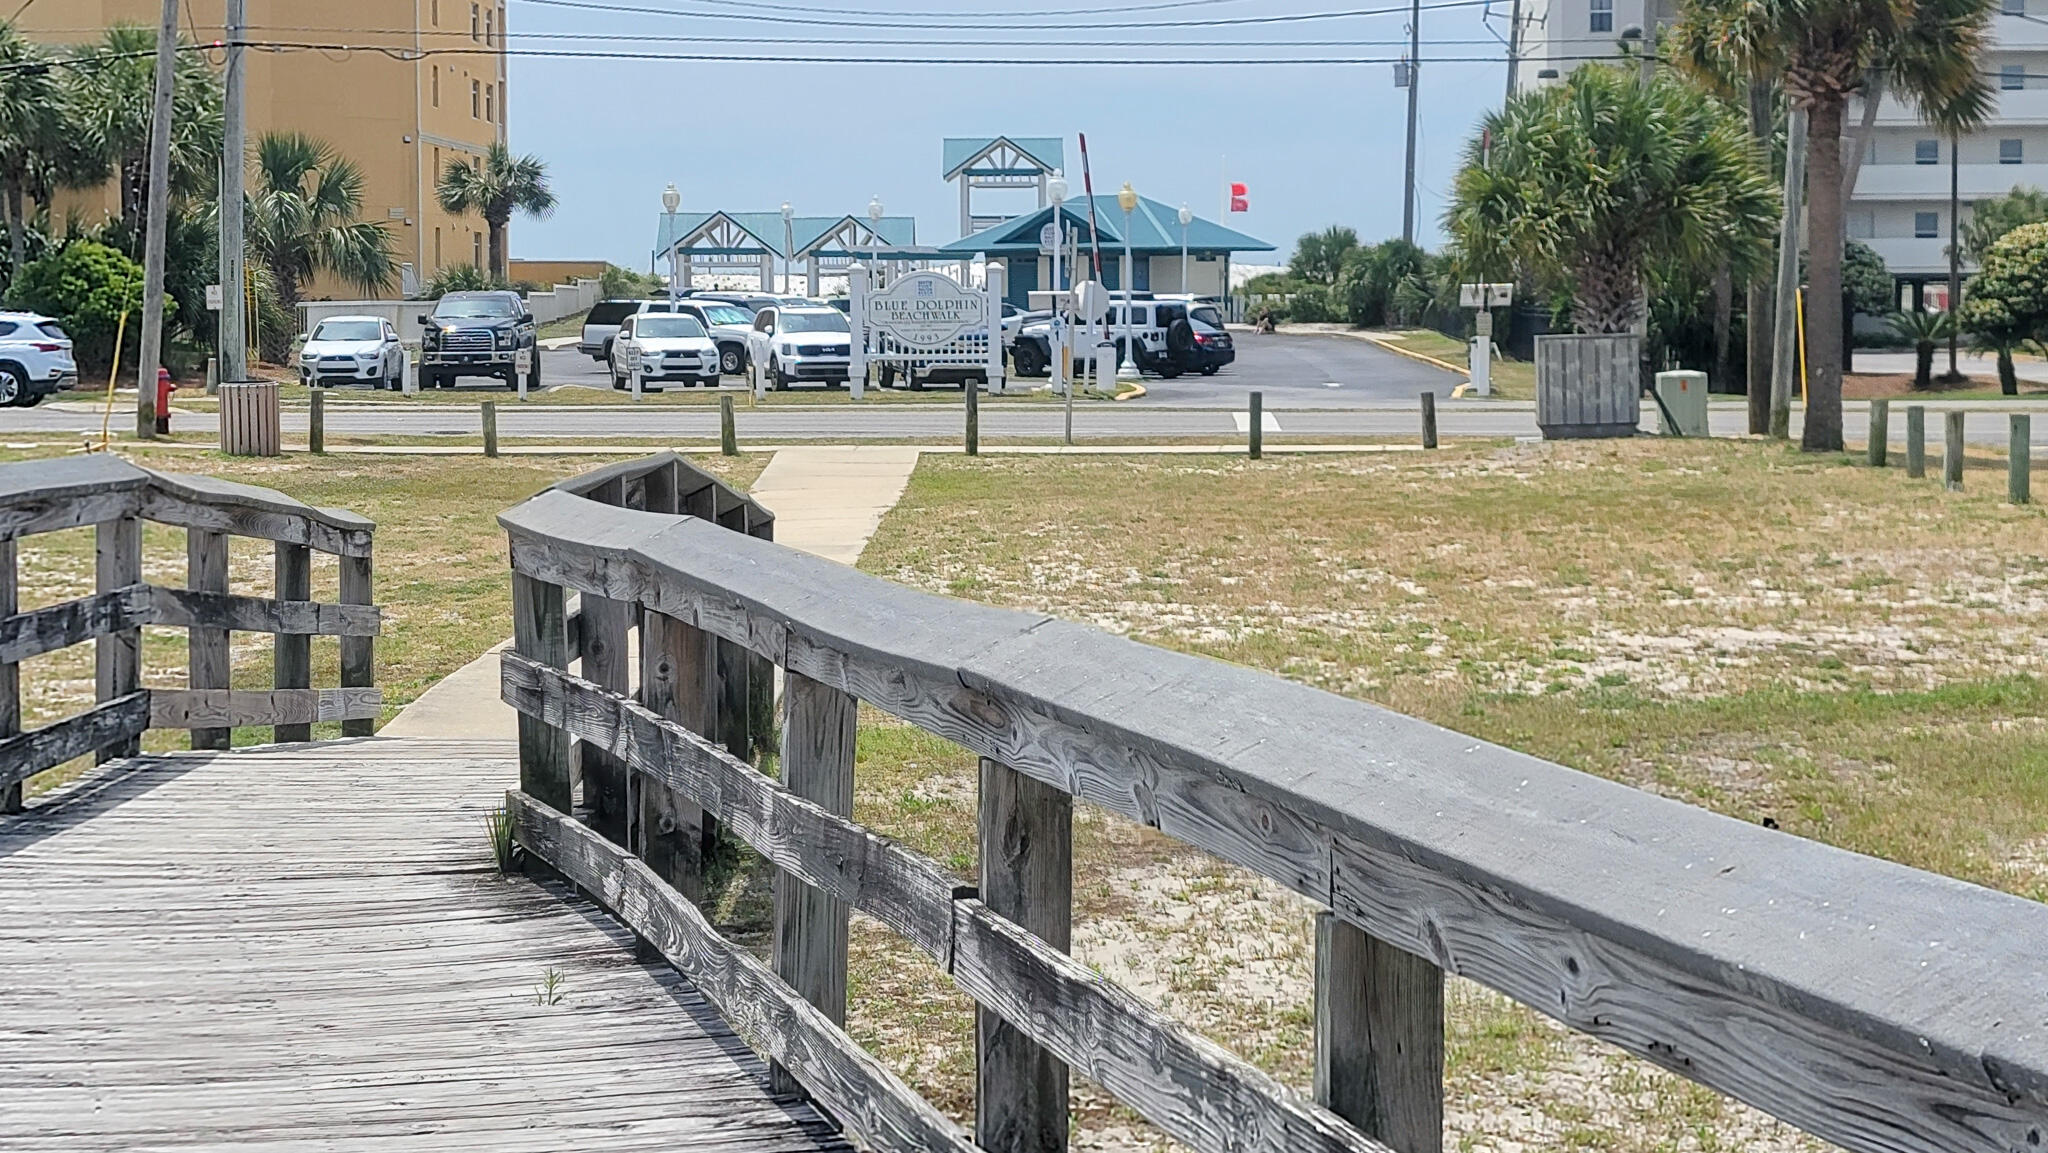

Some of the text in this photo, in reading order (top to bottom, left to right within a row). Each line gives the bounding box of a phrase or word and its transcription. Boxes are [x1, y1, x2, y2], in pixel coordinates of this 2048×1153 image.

[875, 300, 977, 310] BLUE DOLPHIN
[892, 311, 961, 320] BEACHWALK
